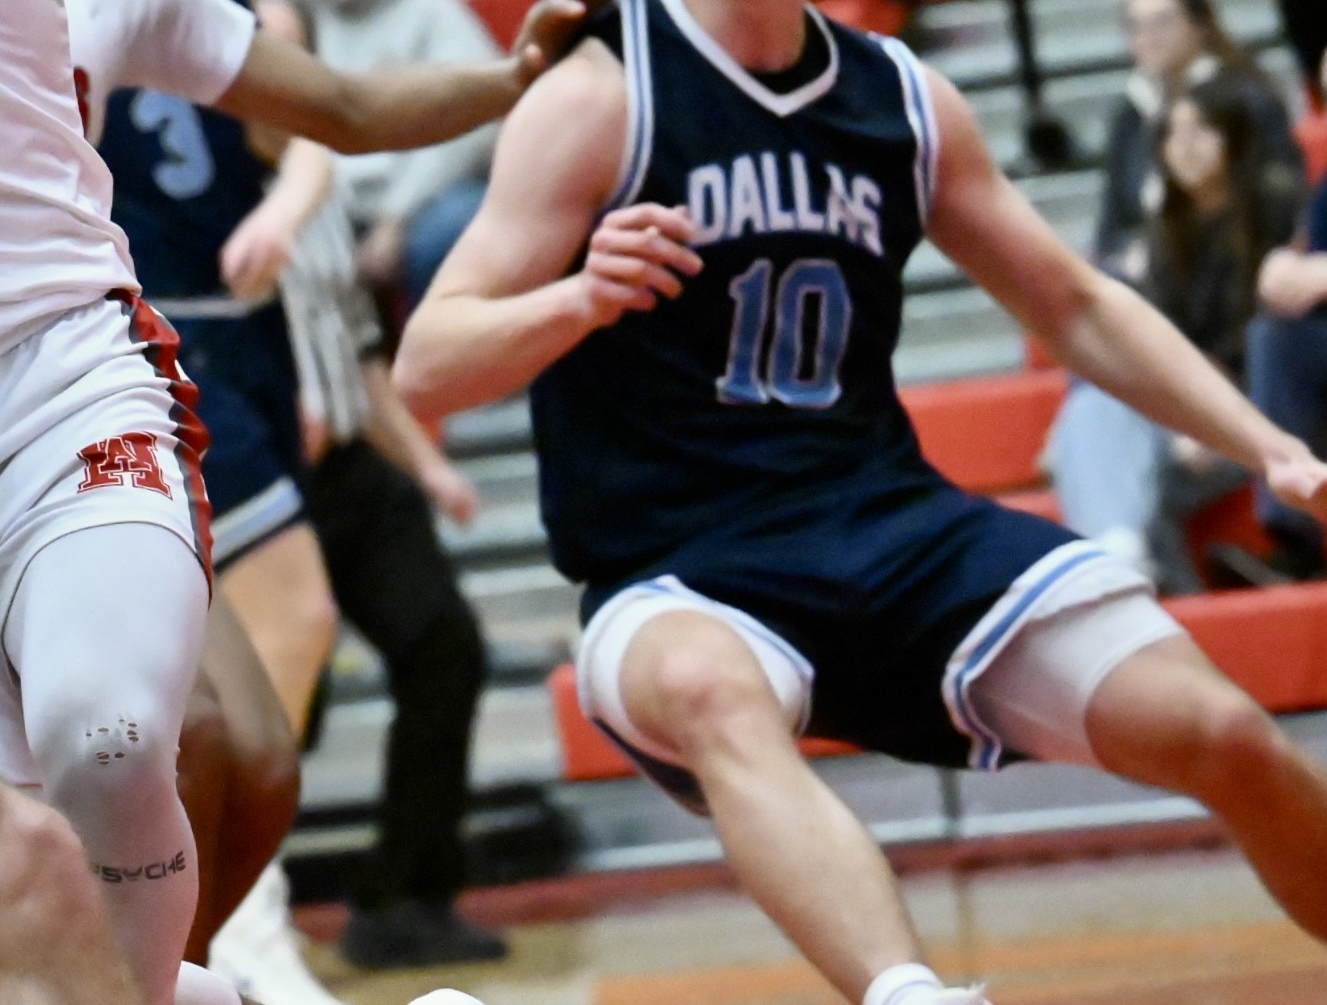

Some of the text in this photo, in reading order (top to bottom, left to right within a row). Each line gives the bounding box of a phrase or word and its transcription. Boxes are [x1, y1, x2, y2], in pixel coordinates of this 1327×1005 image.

[129, 88, 217, 201] 3
[686, 150, 885, 258] DALLAS
[715, 258, 853, 409] 10
